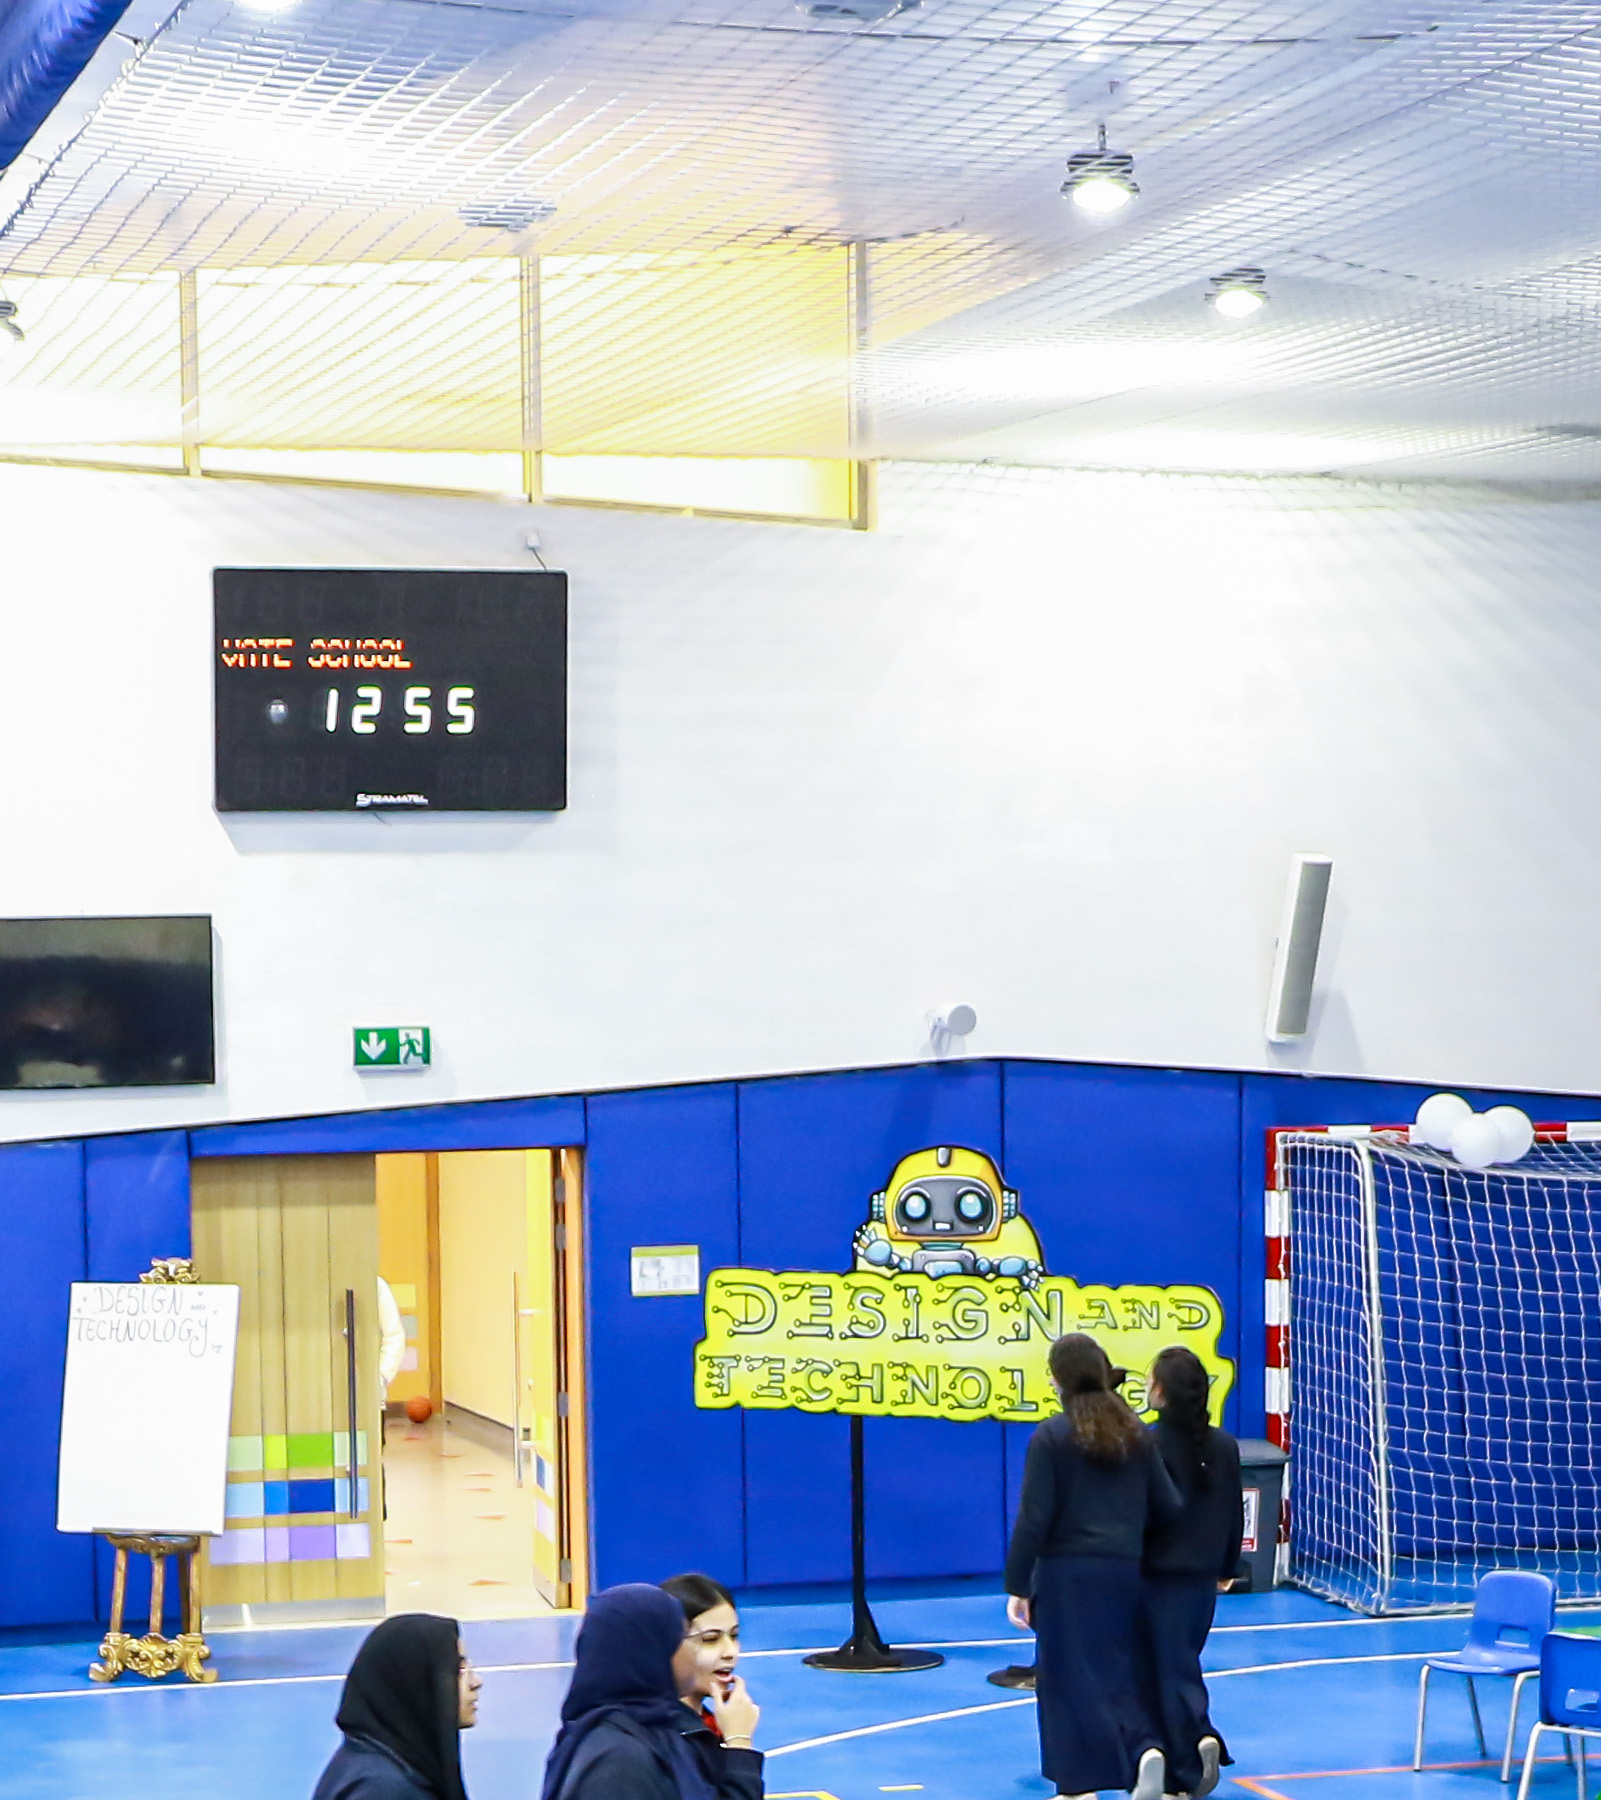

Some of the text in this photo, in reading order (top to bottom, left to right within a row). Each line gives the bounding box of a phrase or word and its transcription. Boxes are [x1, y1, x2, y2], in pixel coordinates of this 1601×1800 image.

[306, 637, 413, 669] SCHOOL
[92, 1285, 183, 1316] DESIGN
[708, 1282, 1213, 1344] DESIGN AND
[71, 1317, 208, 1358] TECHNOLOGY
[700, 1354, 1218, 1417] TECHNOLG
